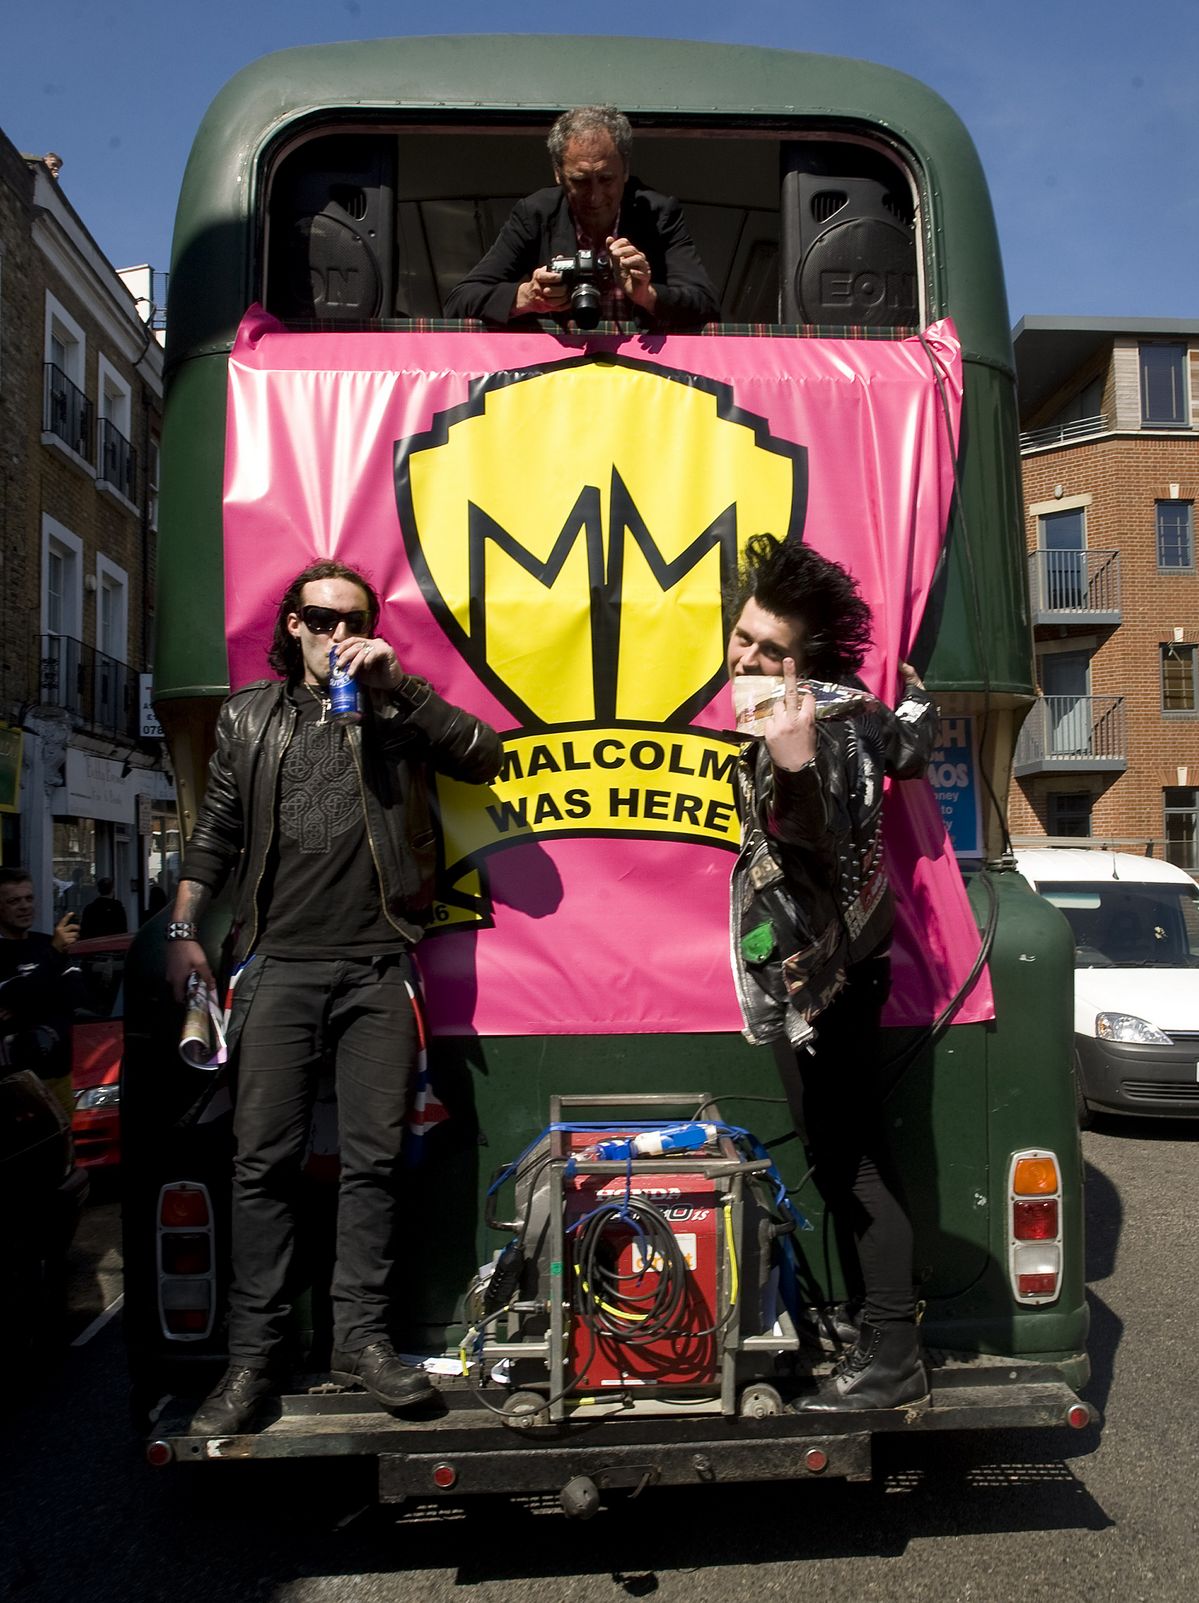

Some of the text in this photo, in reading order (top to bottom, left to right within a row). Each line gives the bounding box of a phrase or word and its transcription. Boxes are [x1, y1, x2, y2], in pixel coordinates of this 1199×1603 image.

[488, 739, 739, 786] MALCOLM
[485, 788, 592, 832] WAS
[609, 787, 735, 833] HERE
